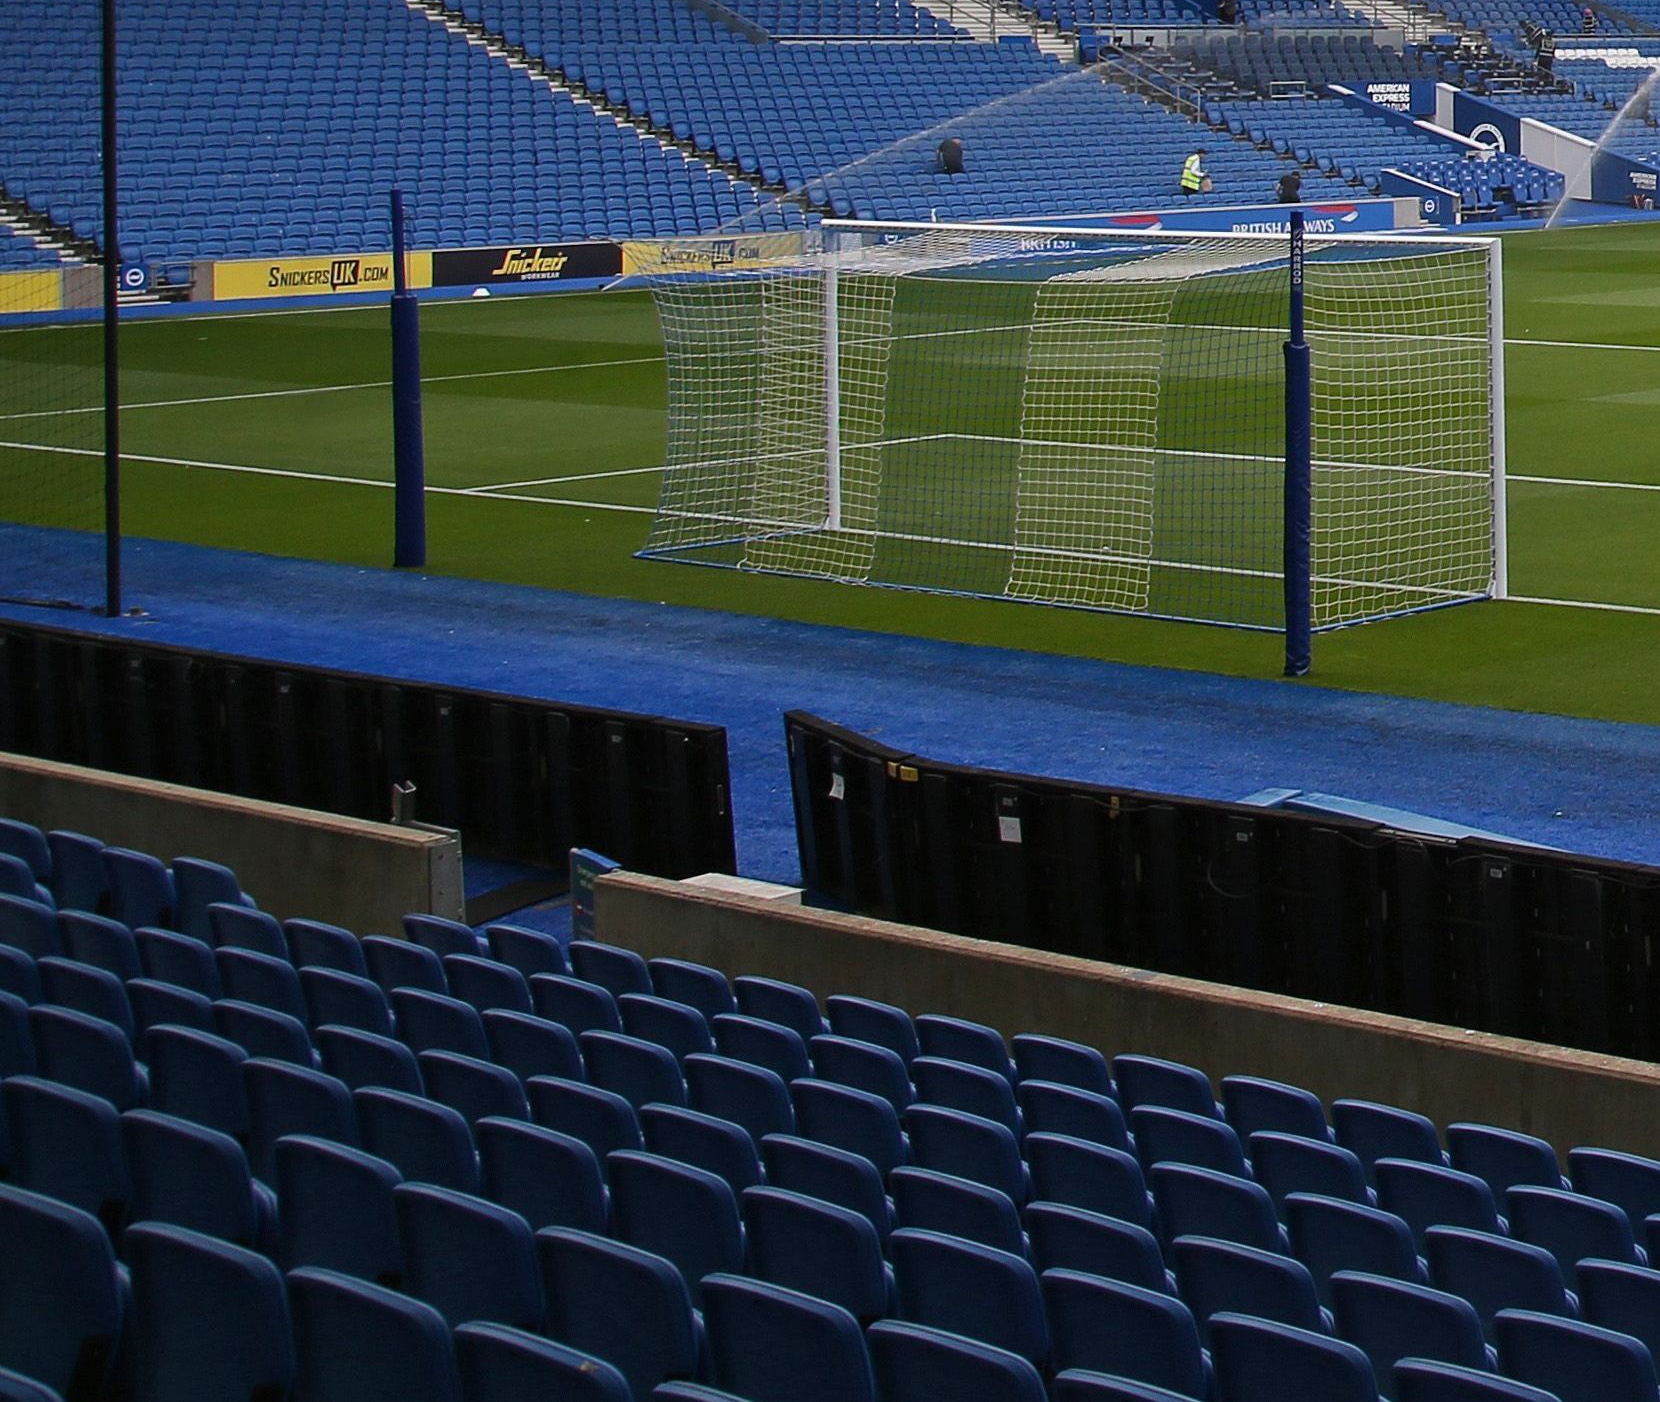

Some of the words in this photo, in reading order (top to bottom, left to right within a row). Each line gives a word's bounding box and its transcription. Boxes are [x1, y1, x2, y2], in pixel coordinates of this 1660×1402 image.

[1367, 84, 1410, 93] AMERICAN
[1372, 94, 1411, 103] EXPRESS
[1232, 222, 1281, 233] BRITISH
[492, 248, 568, 276] Snickers
[1292, 239, 1302, 285] HARROD
[521, 272, 561, 281] WORKWEAR
